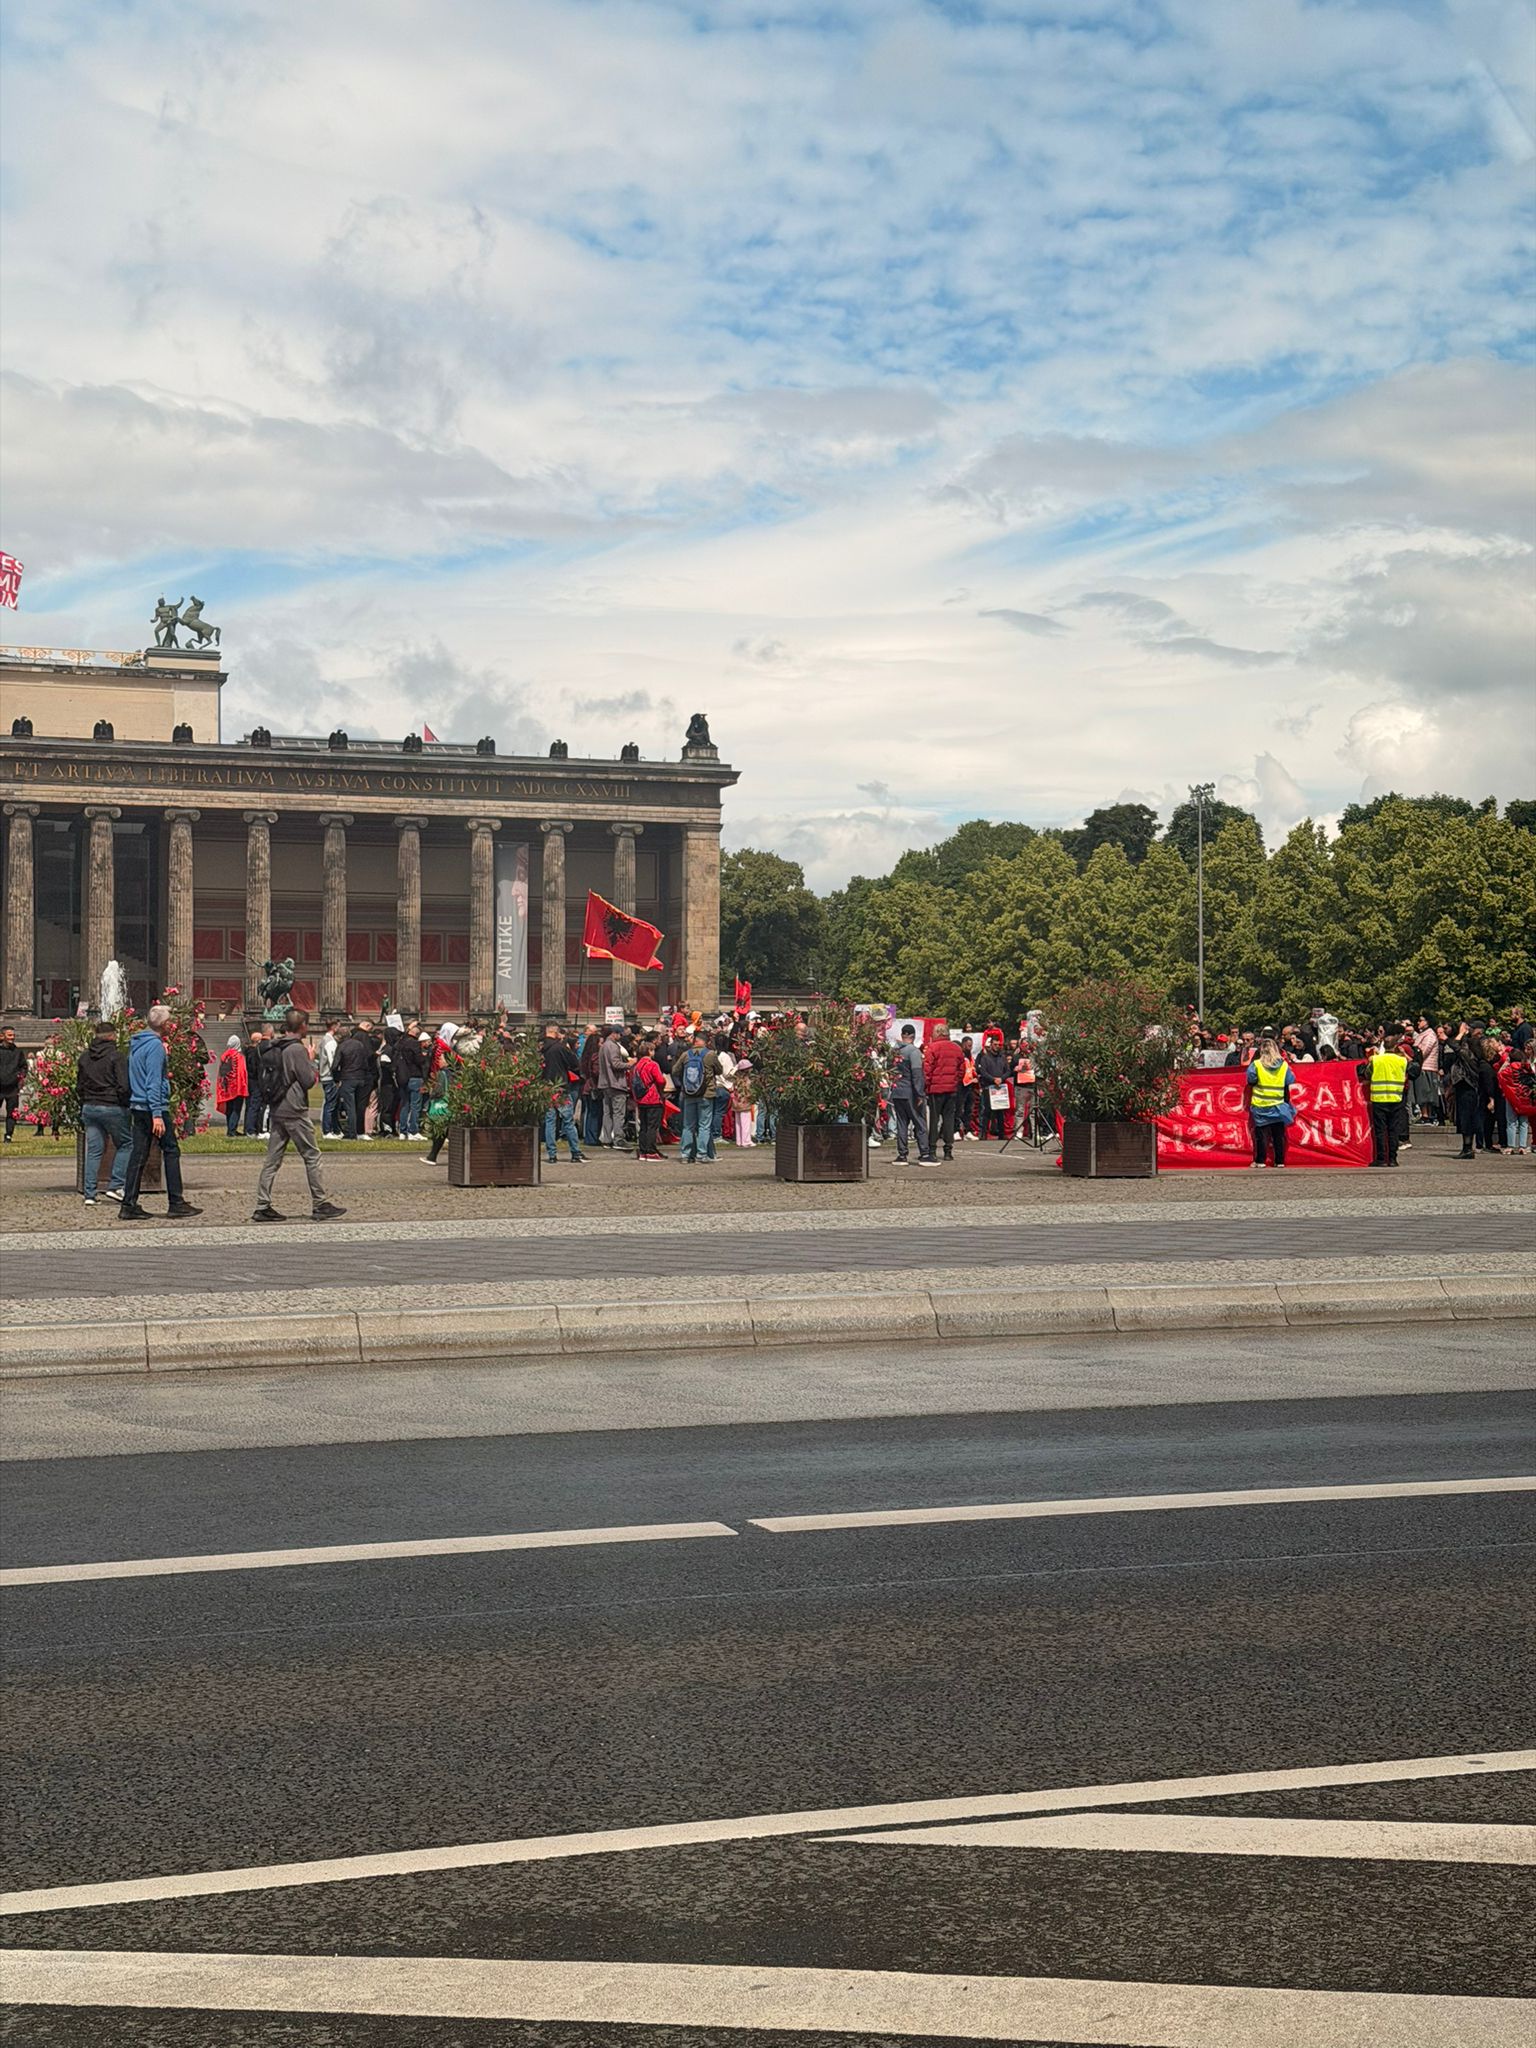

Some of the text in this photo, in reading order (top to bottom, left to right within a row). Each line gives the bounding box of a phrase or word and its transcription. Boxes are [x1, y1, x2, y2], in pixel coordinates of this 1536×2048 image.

[15, 761, 41, 778] ET
[286, 773, 370, 789] MVSEVM
[380, 776, 503, 793] CONSTITVIT
[512, 780, 630, 798] MDCCCXXVIII
[497, 914, 513, 980] ANTIKE
